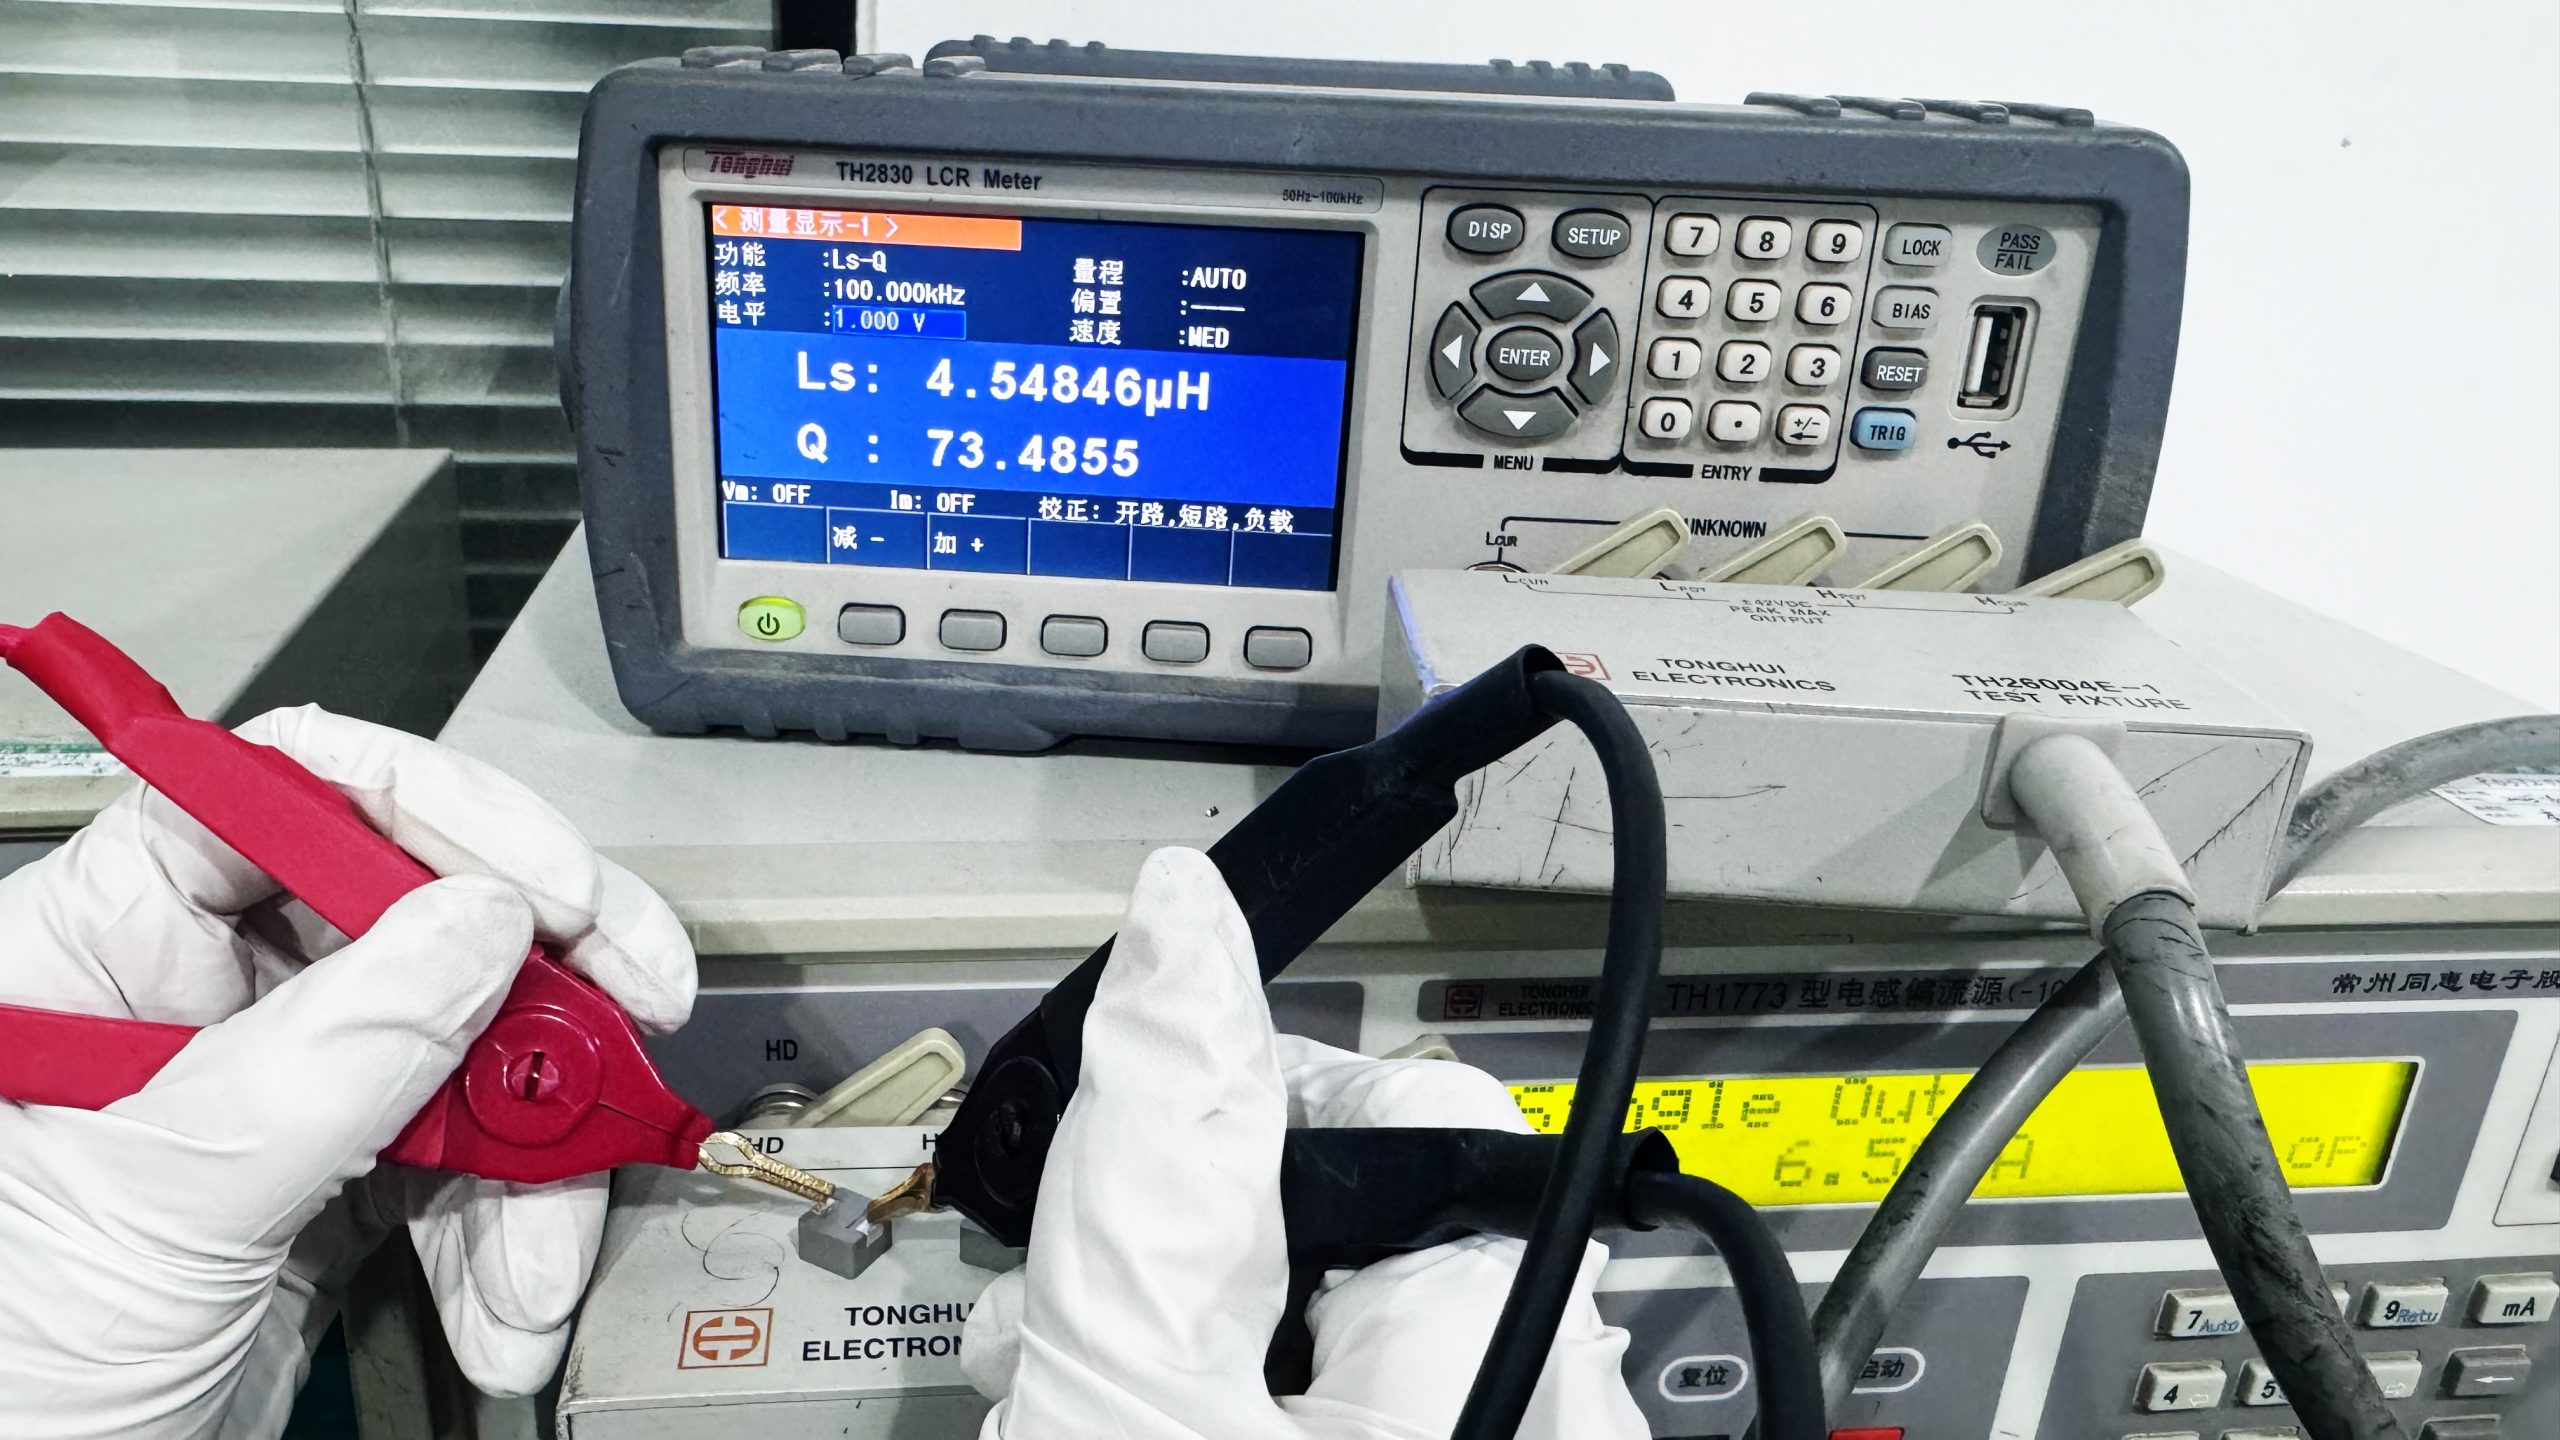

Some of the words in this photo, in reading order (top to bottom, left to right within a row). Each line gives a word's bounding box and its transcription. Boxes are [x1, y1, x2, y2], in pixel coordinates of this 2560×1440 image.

[704, 150, 794, 179] Tonghui
[836, 161, 913, 185] TH2830
[926, 166, 970, 188] LCR
[983, 169, 1042, 191] Meter
[1468, 221, 1512, 240] DISP
[1567, 227, 1621, 246] SETUP
[1689, 225, 1705, 249] 7
[1998, 231, 2041, 250] PASS
[1758, 230, 1775, 254] 8
[1831, 233, 1847, 256] 9
[1902, 238, 1941, 257] LOCK
[714, 241, 767, 267] 功能
[1994, 252, 2034, 271] FAIL
[1072, 257, 1125, 286] 量程
[715, 270, 767, 297] 频率
[1070, 288, 1122, 316] 偏置
[1677, 289, 1694, 311] 4
[1748, 291, 1765, 314] 5
[1819, 296, 1836, 317] 6
[718, 300, 767, 327] 电平
[912, 312, 926, 334] V
[1892, 302, 1931, 320] BIAS
[1069, 319, 1122, 346] 速度
[1499, 347, 1551, 367] ENTER
[1671, 350, 1681, 371] 1
[1739, 354, 1755, 375] 2
[1810, 357, 1826, 378] 3
[796, 350, 879, 393] Ls:
[1876, 365, 1923, 383] RESET
[1660, 411, 1676, 433] 0
[1869, 425, 1907, 442] TRIG
[797, 422, 829, 466] Q
[926, 428, 1141, 479] 73.4855
[1493, 454, 1534, 471] MENU
[1701, 464, 1753, 482] ENTRY
[722, 480, 758, 501] Vm:
[772, 483, 812, 504] OFF
[935, 493, 976, 514] OFF
[832, 525, 858, 550] 减
[1683, 517, 1767, 539] UNKNOWN
[933, 531, 957, 555] 加
[1729, 605, 1782, 615] PEAK
[1789, 608, 1831, 617] MAX
[1750, 614, 1824, 625] OUTPUT
[1656, 658, 1786, 675] TONGHUI
[1632, 671, 1837, 692] ELECTRONICS
[1952, 674, 2161, 695] TH26004E-1
[1963, 690, 2042, 704] TEST
[2058, 693, 2192, 710] FIXTURE
[1666, 980, 1788, 1012] TH1773
[766, 1039, 798, 1061] HD
[1514, 1079, 1781, 1133] Sgle
[2384, 1300, 2401, 1321] 9
[2502, 1298, 2536, 1318] mA
[2187, 1310, 2203, 1330] 7
[2163, 1384, 2179, 1405] 4
[2260, 1383, 2276, 1399] 5
